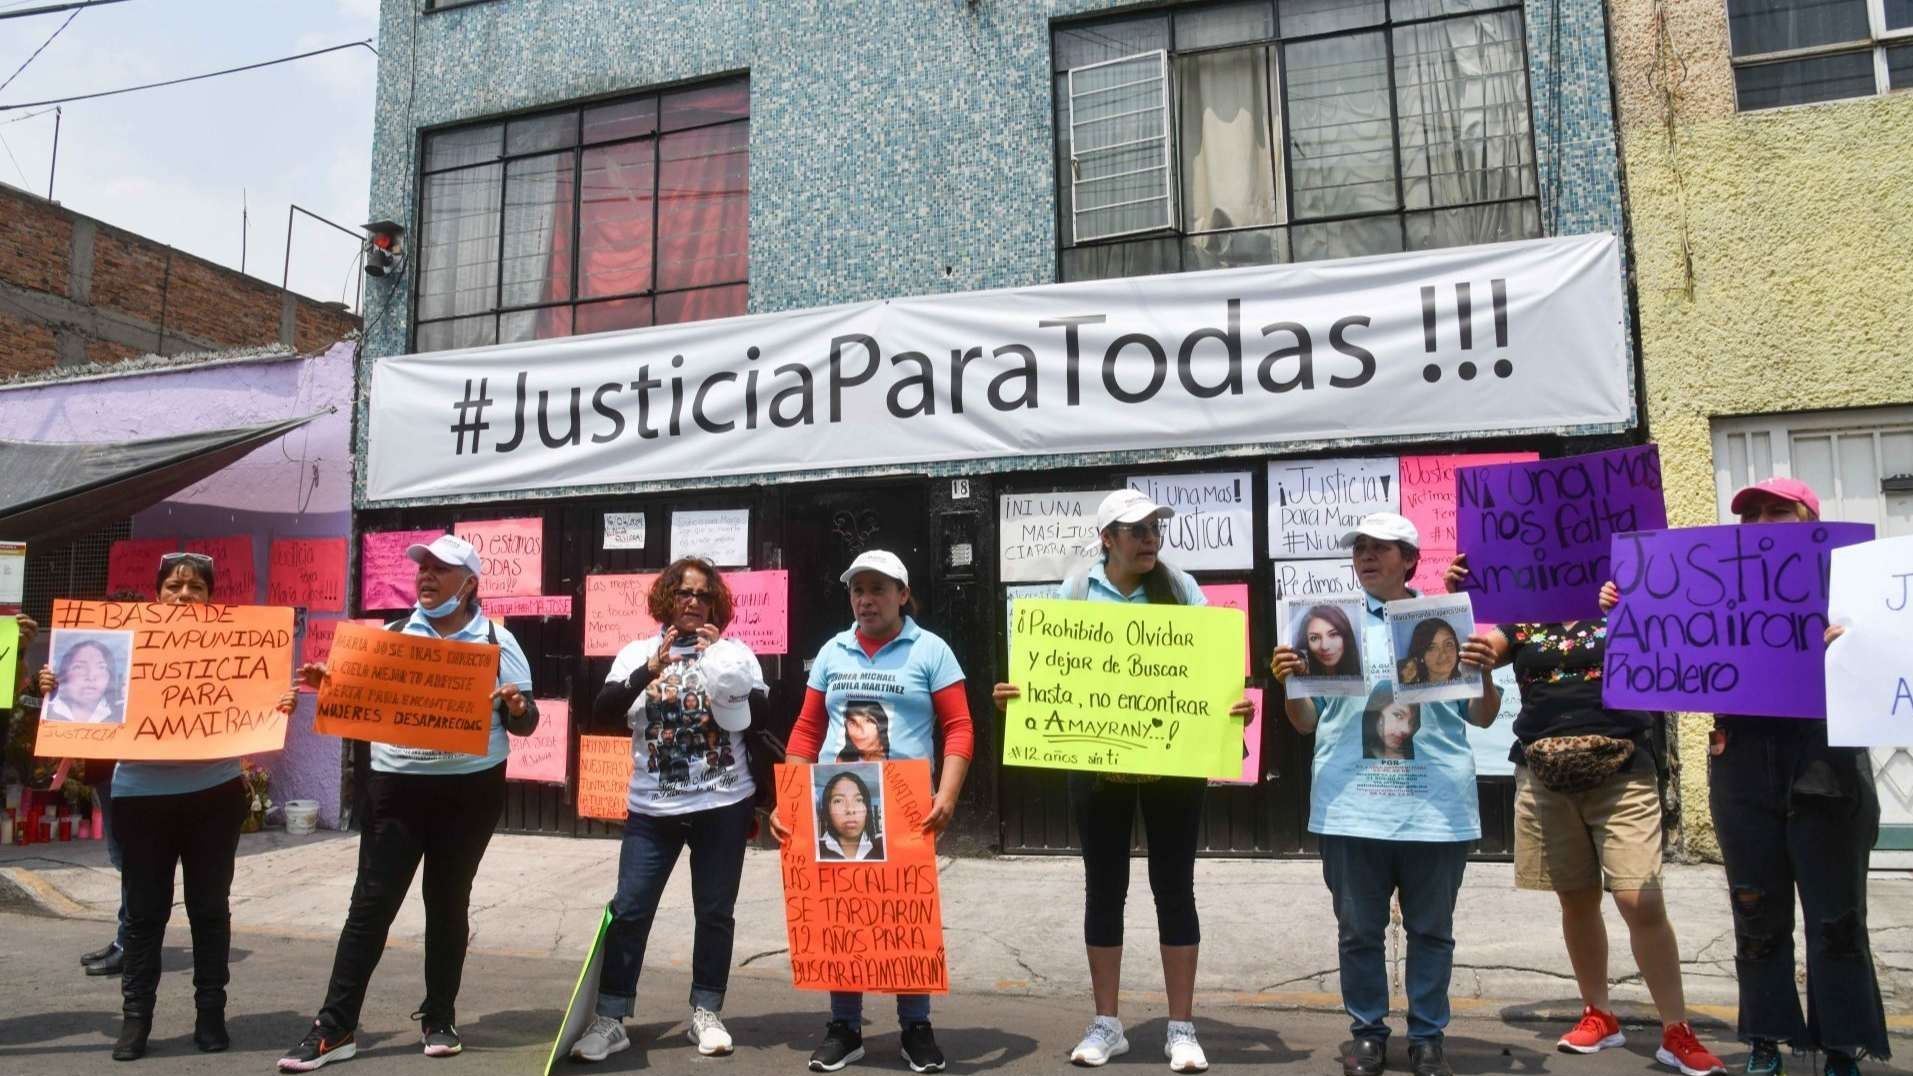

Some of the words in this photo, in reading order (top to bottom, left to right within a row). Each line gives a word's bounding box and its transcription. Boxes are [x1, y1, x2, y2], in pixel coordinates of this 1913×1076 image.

[450, 298, 1376, 455] #JusticiaParaTodas
[1420, 278, 1515, 384] !!!
[952, 481, 968, 495] 18
[1040, 499, 1082, 518] UNA
[1281, 506, 1320, 529] para
[1481, 509, 1547, 547] nos
[1555, 498, 1637, 546] falta
[489, 532, 541, 555] estamos
[1462, 548, 1612, 595] Amairan
[1612, 527, 1830, 607] Justici
[1605, 600, 1829, 655] Amairan
[131, 656, 269, 681] JUSTICIA
[1103, 654, 1121, 674] de
[1127, 653, 1189, 678] Buscar
[162, 682, 233, 709] PARA
[1089, 693, 1111, 708] no
[1117, 690, 1211, 717] encontrar
[319, 703, 382, 723] MUJERES
[1025, 717, 1038, 731] a
[1105, 748, 1119, 764] ti
[818, 865, 935, 895] FISCALIAS
[786, 898, 817, 923] SE
[821, 897, 934, 926] TARDARON
[791, 927, 812, 955] 12
[872, 925, 926, 950] PARA
